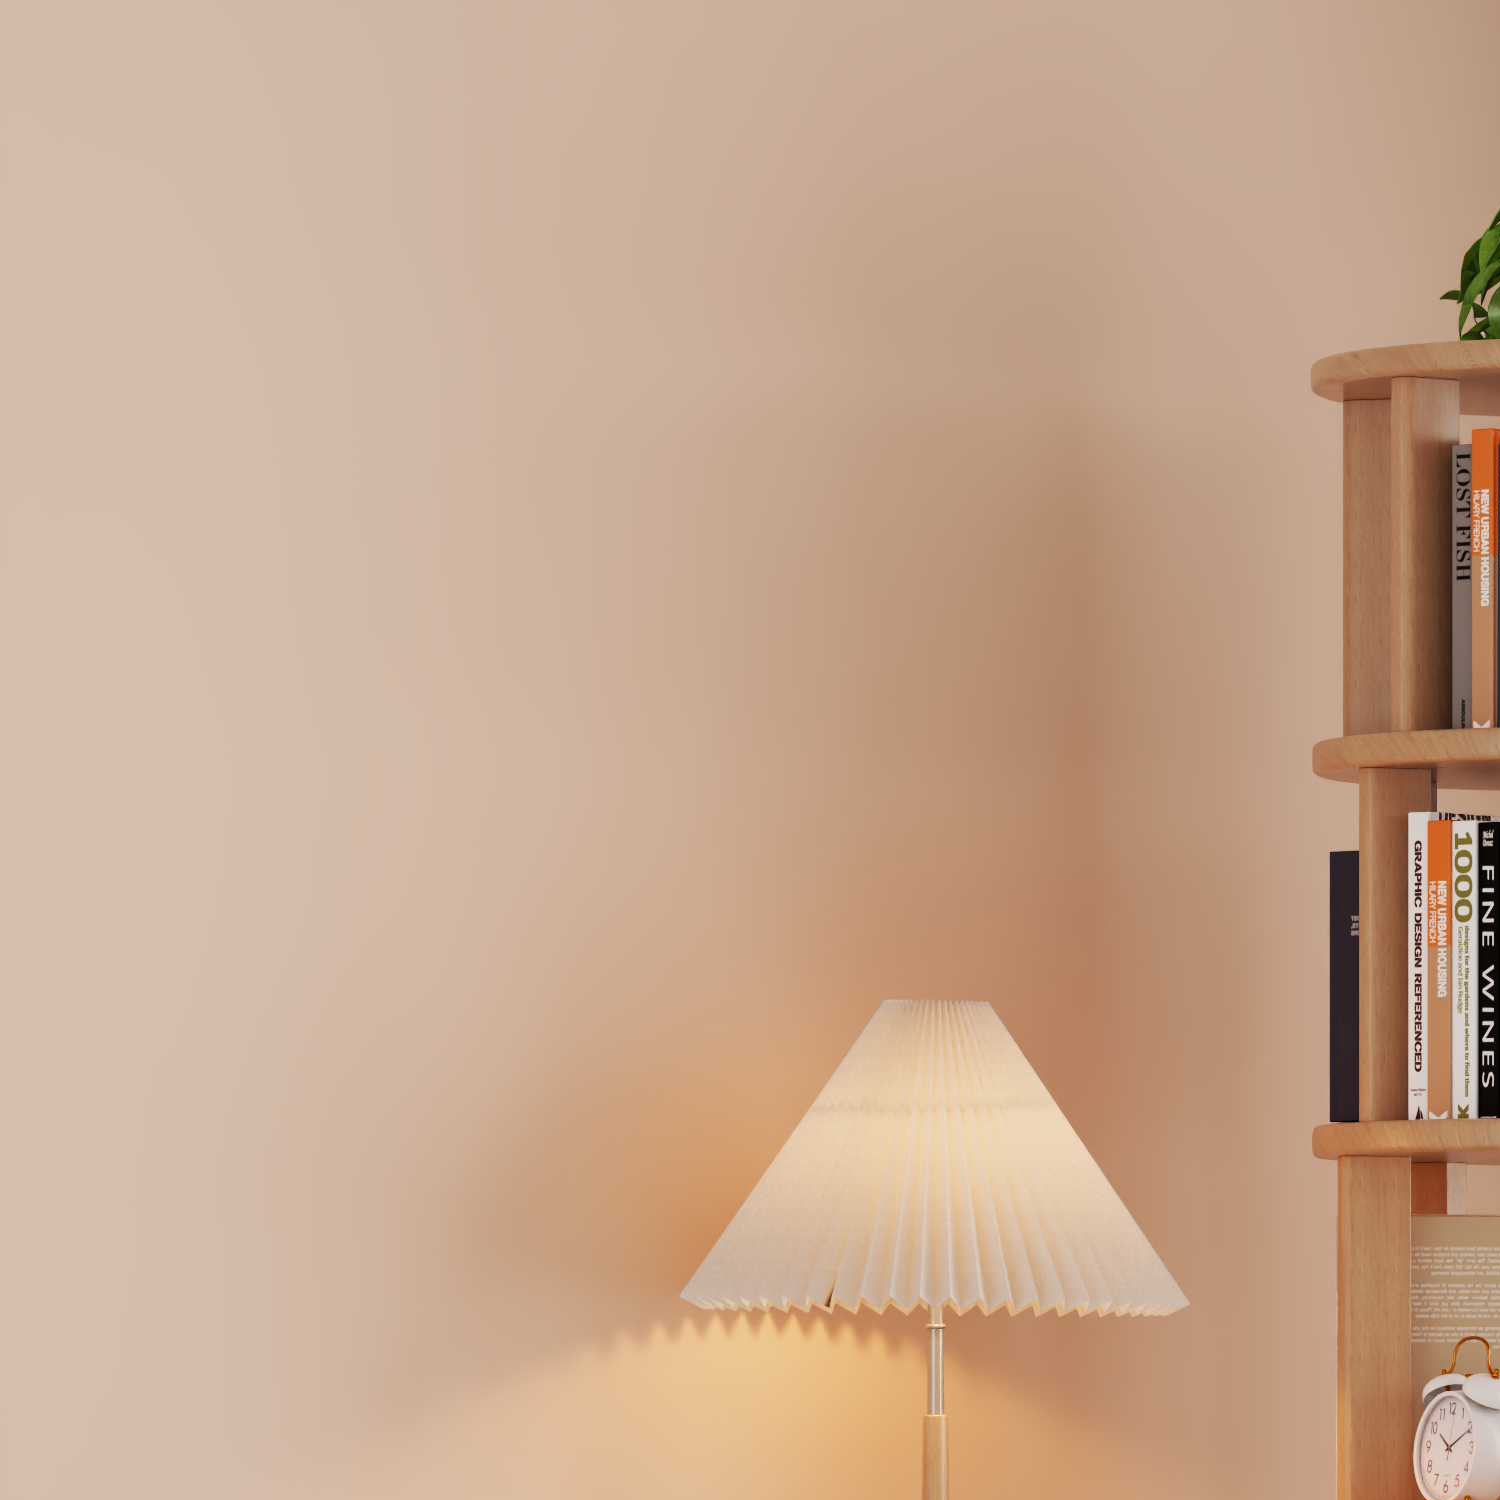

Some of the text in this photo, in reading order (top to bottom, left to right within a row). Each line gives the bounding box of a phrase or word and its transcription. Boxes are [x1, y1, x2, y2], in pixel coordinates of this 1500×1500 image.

[1456, 453, 1471, 580] LOST FISH
[1481, 489, 1490, 606] NEW URBAN HOUSING
[1454, 832, 1473, 923] 1000
[1429, 881, 1437, 944] HILARY FRENCH
[1437, 880, 1447, 998] NEW URBAN HOUSING
[1414, 840, 1422, 1072] GRAPHIC DESIGN REFERENCED
[1482, 865, 1495, 1088] FINE WINES
[1439, 1408, 1446, 1420] 11
[1450, 1403, 1456, 1415] 12
[1431, 1422, 1438, 1435] 10
[1426, 1440, 1432, 1453] 9
[1427, 1460, 1432, 1473] 8
[1464, 1461, 1469, 1472] 4
[1434, 1474, 1440, 1486] 7
[1443, 1480, 1448, 1493] 6
[1454, 1474, 1460, 1488] 5
